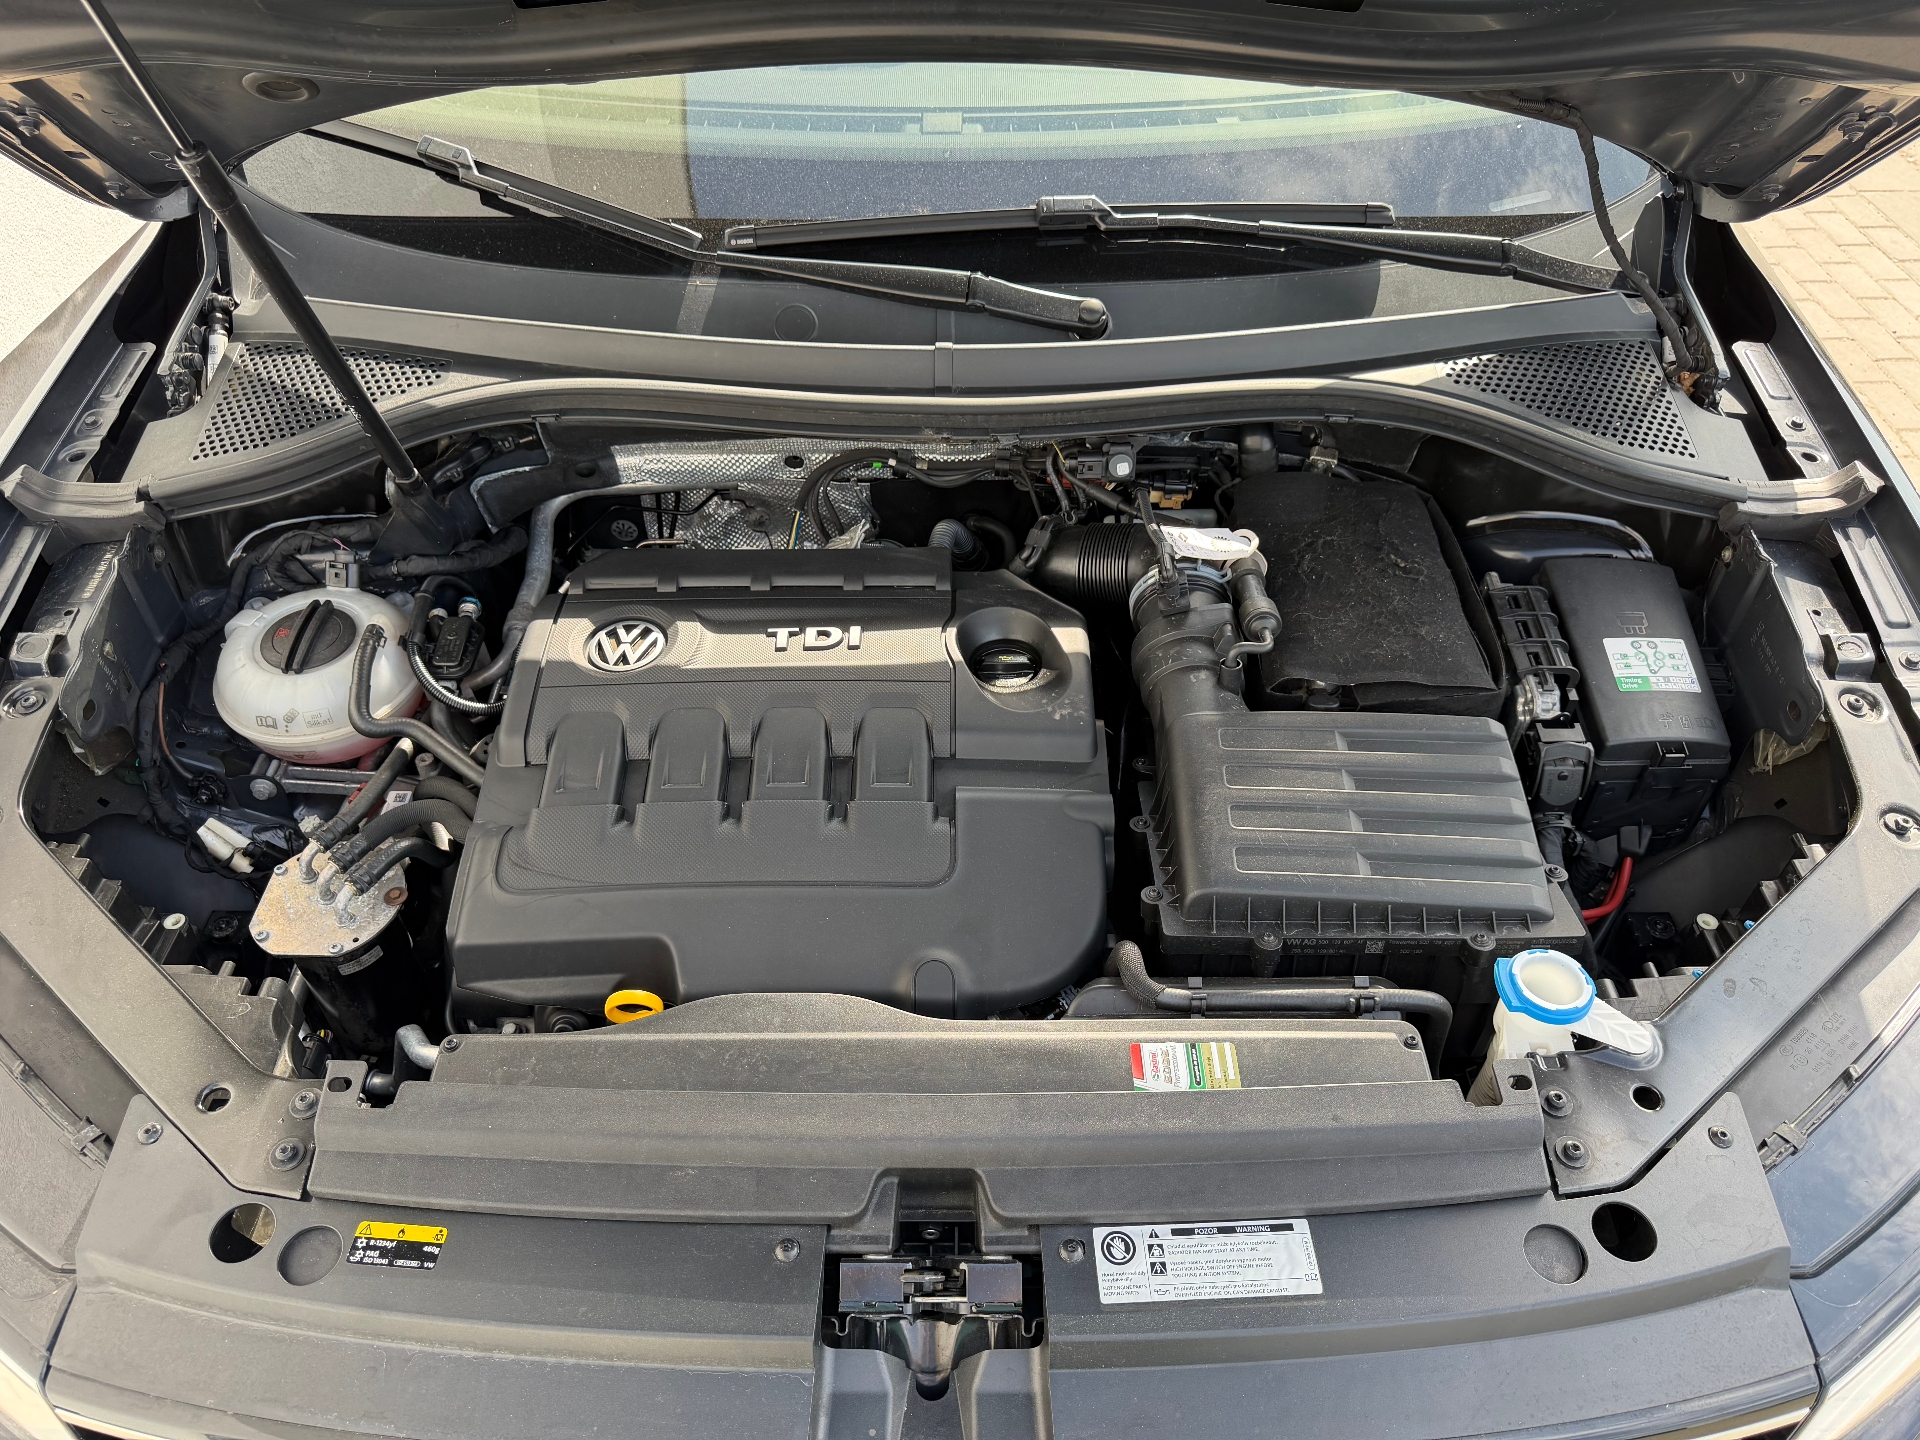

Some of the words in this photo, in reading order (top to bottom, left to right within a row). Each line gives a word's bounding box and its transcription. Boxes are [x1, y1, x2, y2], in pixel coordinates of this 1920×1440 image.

[766, 626, 862, 652] TDI
[1235, 1225, 1271, 1233] WARNING
[369, 1240, 397, 1249] R-1234yf
[423, 1246, 440, 1254] 460g
